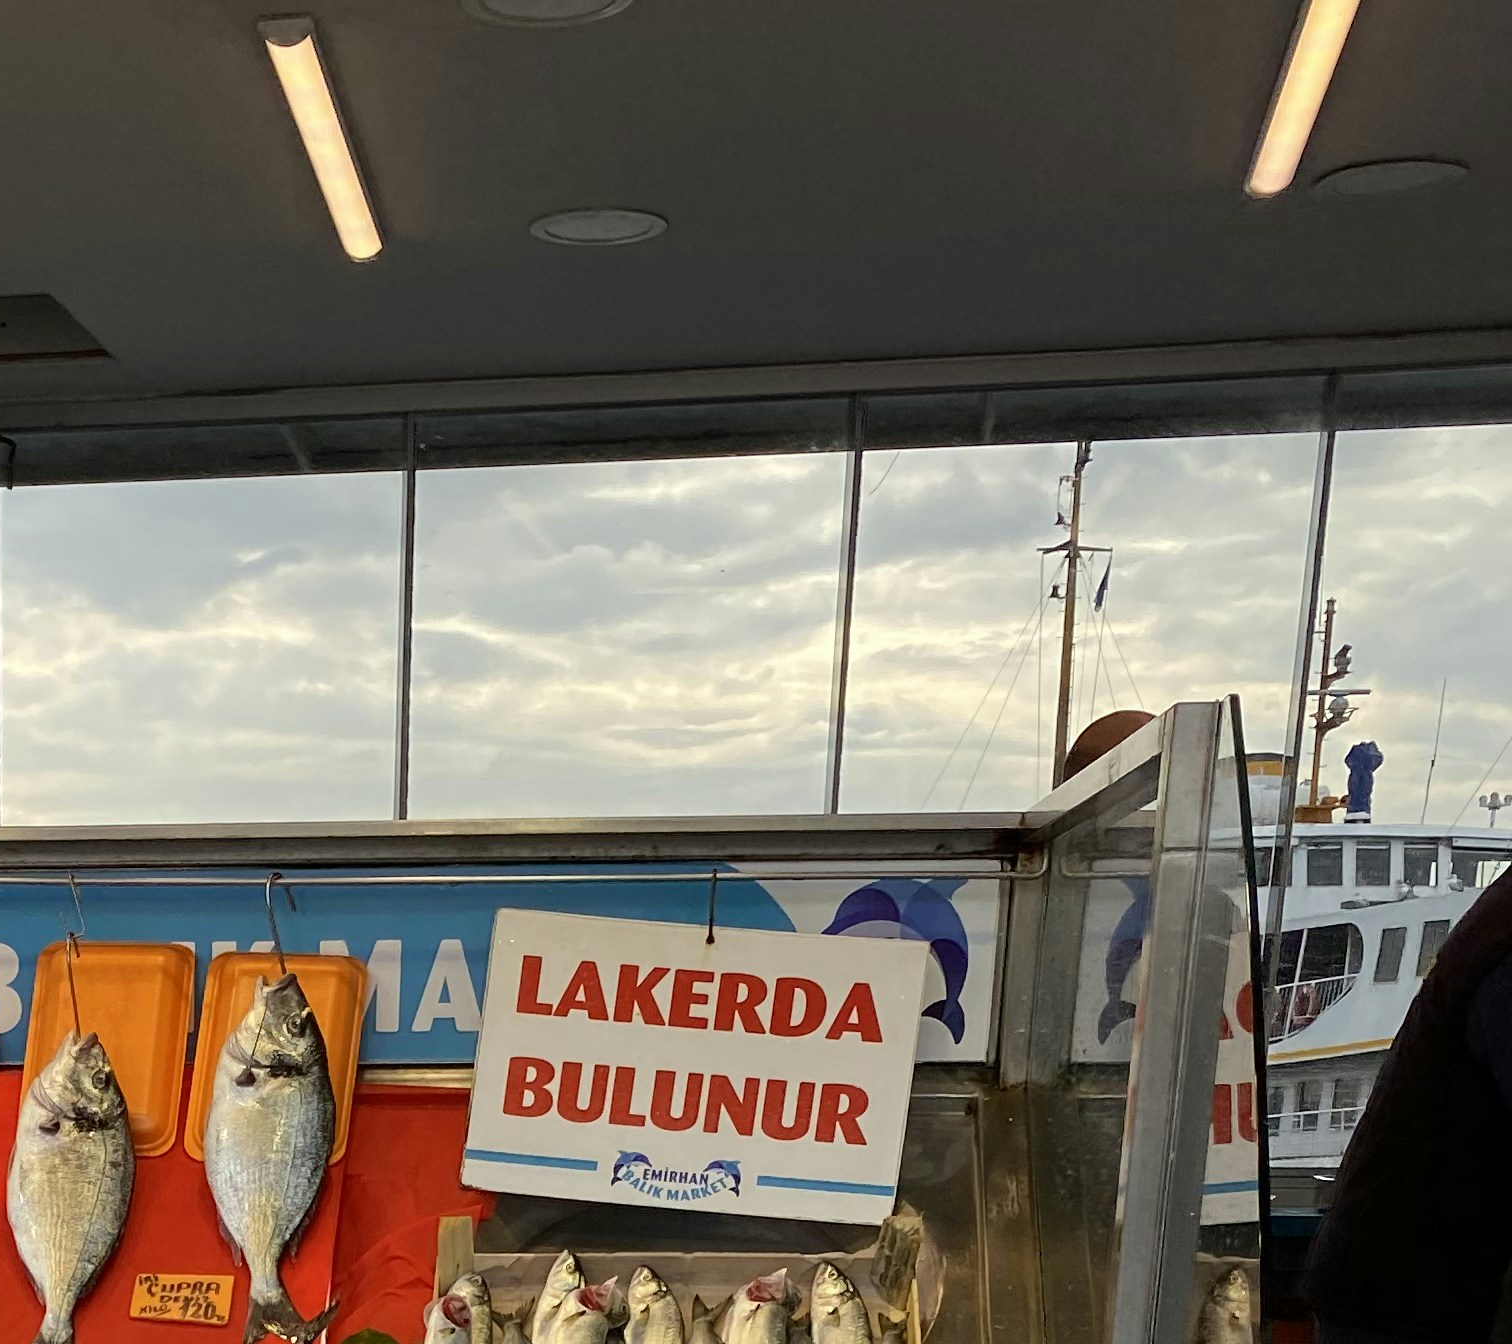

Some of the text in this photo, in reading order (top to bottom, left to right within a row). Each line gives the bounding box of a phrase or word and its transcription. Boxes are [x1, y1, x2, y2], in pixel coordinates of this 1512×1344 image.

[516, 955, 884, 1043] LAKERDA
[502, 1057, 870, 1146] BULUNUR
[621, 1169, 728, 1202] BALIK MARKET
[642, 1166, 710, 1186] EMİRHAN
[179, 1301, 217, 1320] 120
